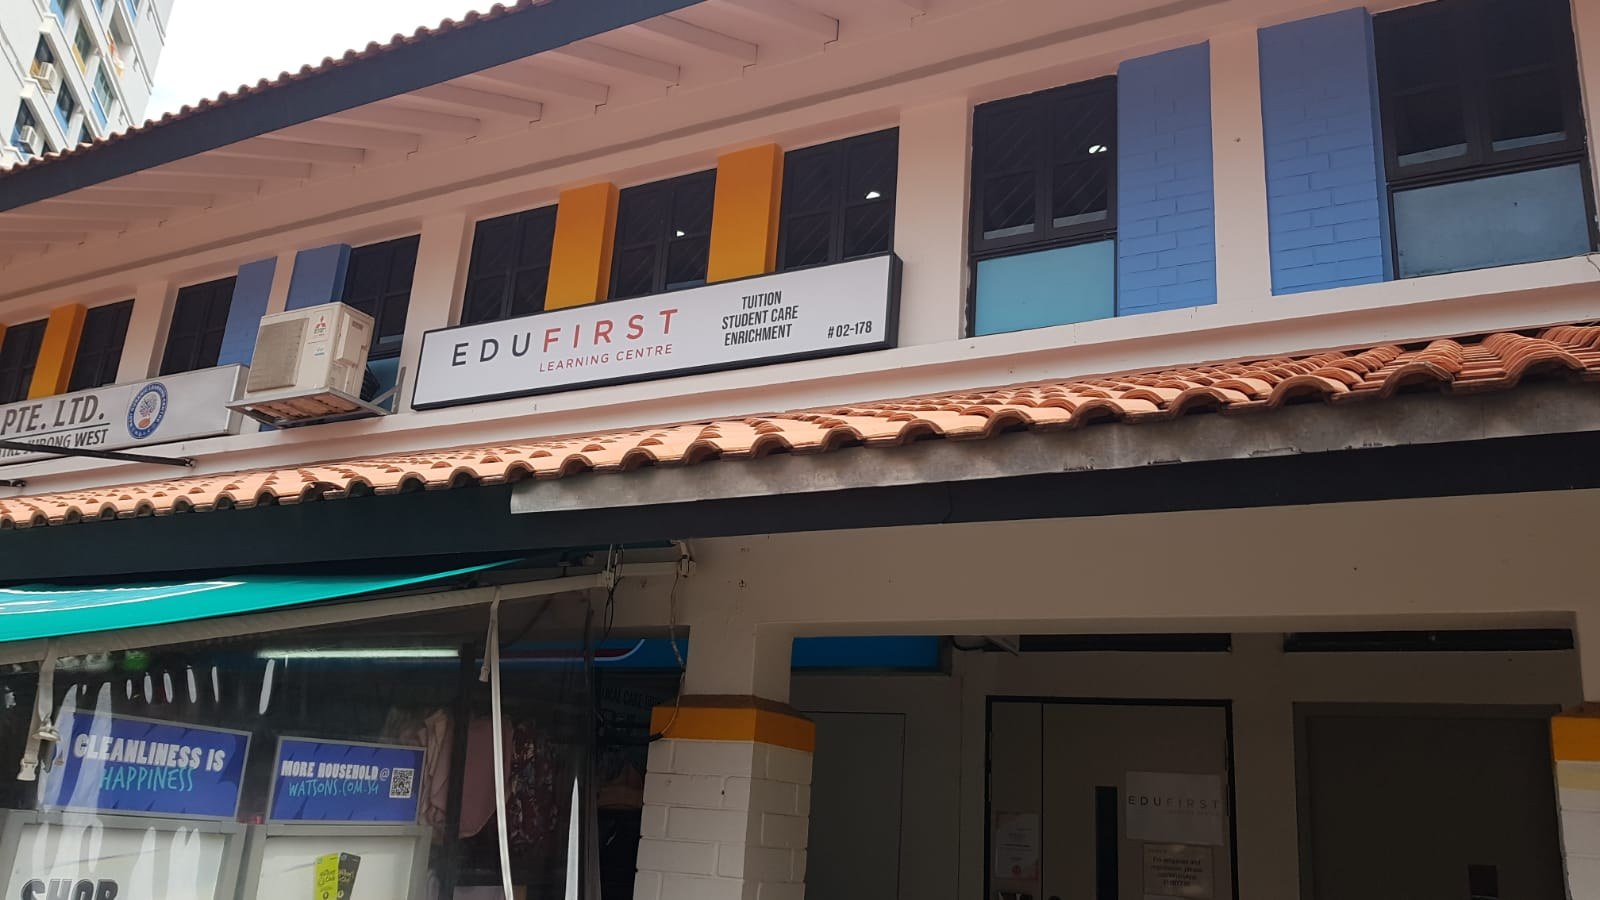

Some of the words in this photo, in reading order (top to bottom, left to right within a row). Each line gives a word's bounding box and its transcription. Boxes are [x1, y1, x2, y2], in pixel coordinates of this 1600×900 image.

[742, 291, 782, 310] TUITION
[721, 309, 769, 330] STUDENT
[771, 305, 799, 323] CARE
[827, 320, 873, 339] #02-178
[452, 308, 678, 366] EDUFIRST
[724, 323, 793, 346] ENRICHMENT
[539, 353, 609, 373] LEARNING
[616, 343, 673, 362] CENTRE
[0, 403, 46, 435] PTE.
[53, 395, 104, 427] LTD.
[74, 429, 109, 447] WEST
[73, 733, 202, 770] CLEANLINESS
[205, 748, 225, 772] IS
[99, 766, 197, 792] HAPPINESS
[281, 760, 315, 777] MORE
[1128, 795, 1220, 809] EDUFIRST
